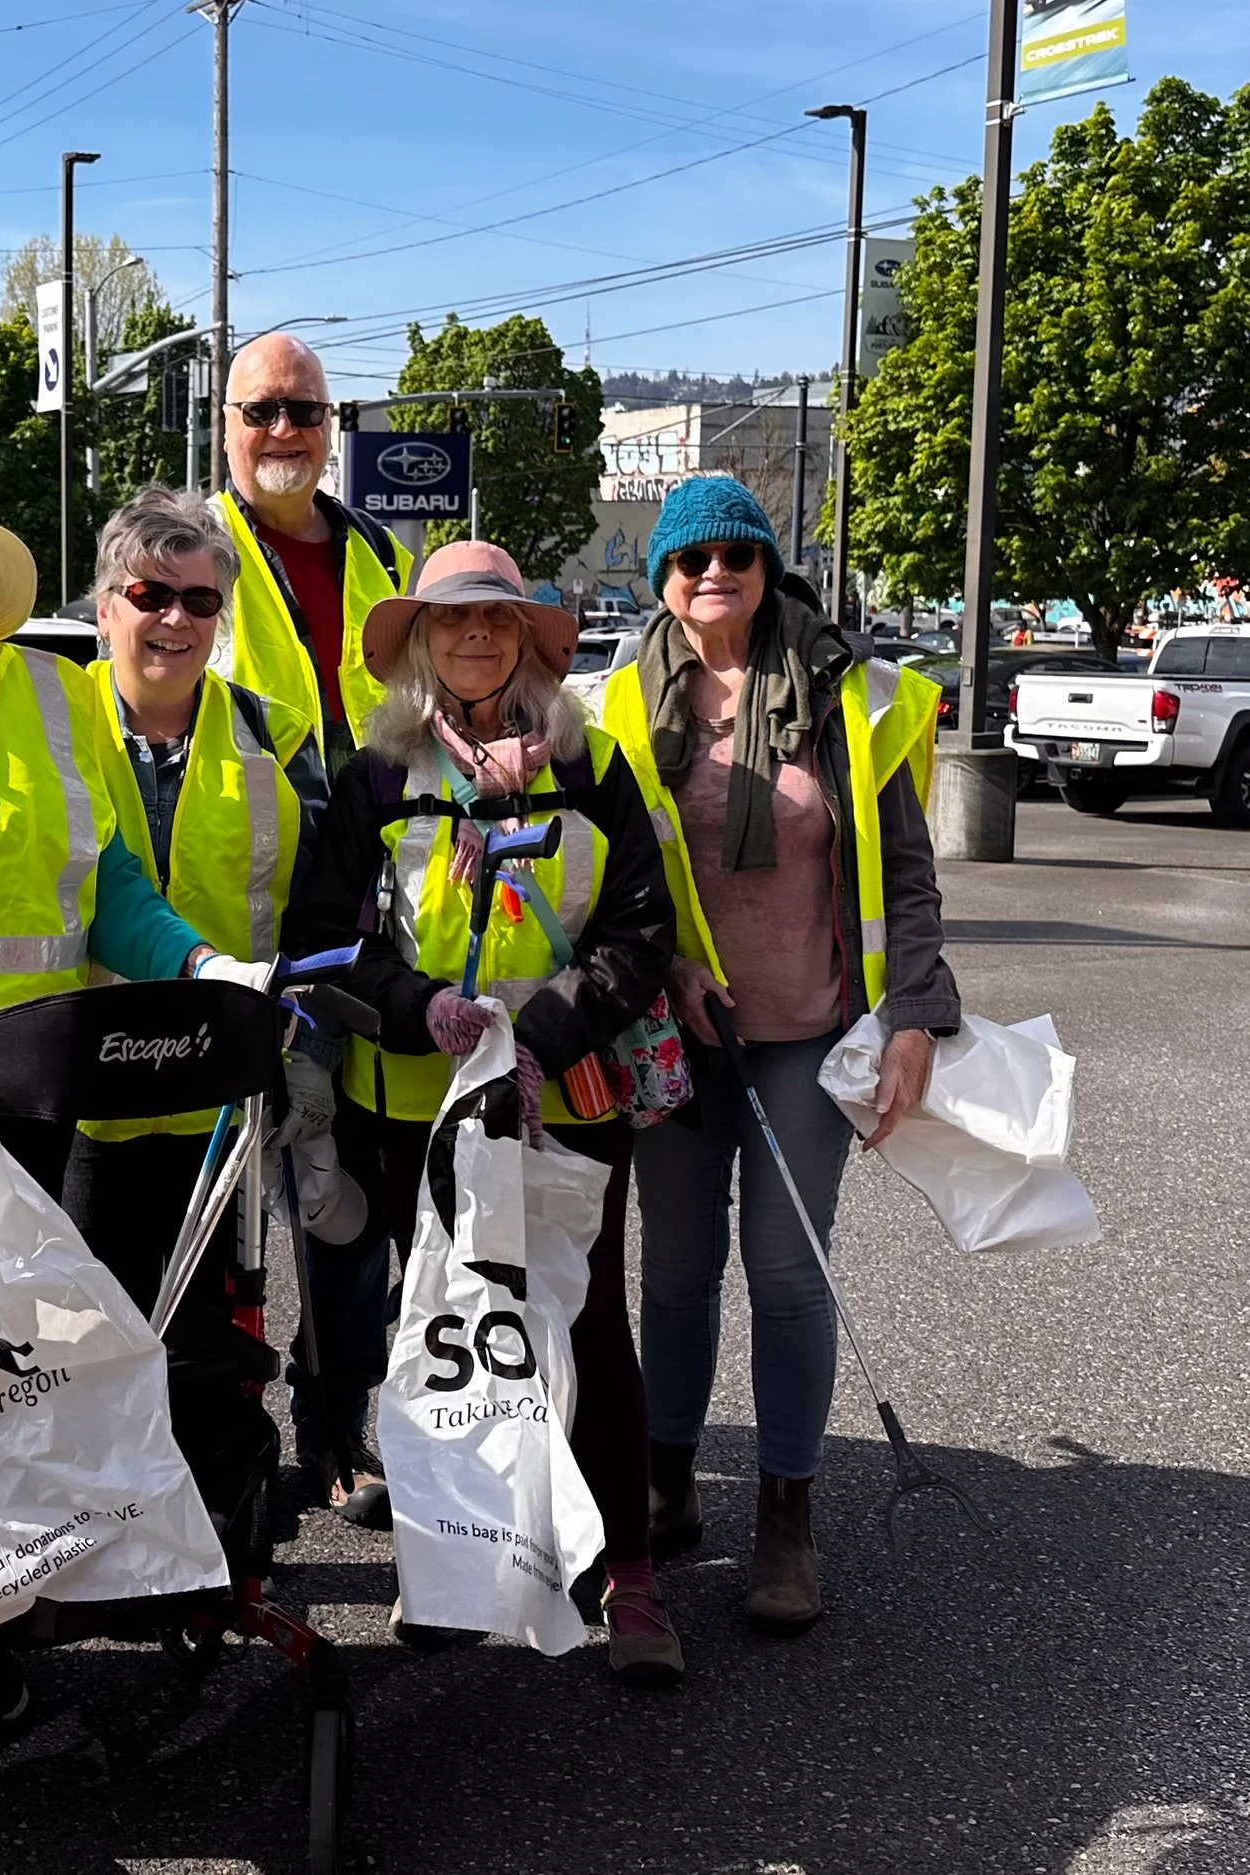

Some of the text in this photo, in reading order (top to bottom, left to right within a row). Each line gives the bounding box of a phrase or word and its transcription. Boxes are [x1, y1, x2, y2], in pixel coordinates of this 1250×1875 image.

[1025, 28, 1120, 62] CROSSTREK
[870, 280, 895, 289] SUBA
[365, 494, 459, 511] SUBARU
[1048, 723, 1122, 732] TACOMA
[425, 1311, 548, 1392] SO
[15, 1520, 75, 1560] donations
[74, 1511, 90, 1525] to
[436, 1519, 468, 1536] This
[471, 1523, 498, 1542] bag
[501, 1527, 512, 1542] is
[52, 1536, 98, 1570] plastic.
